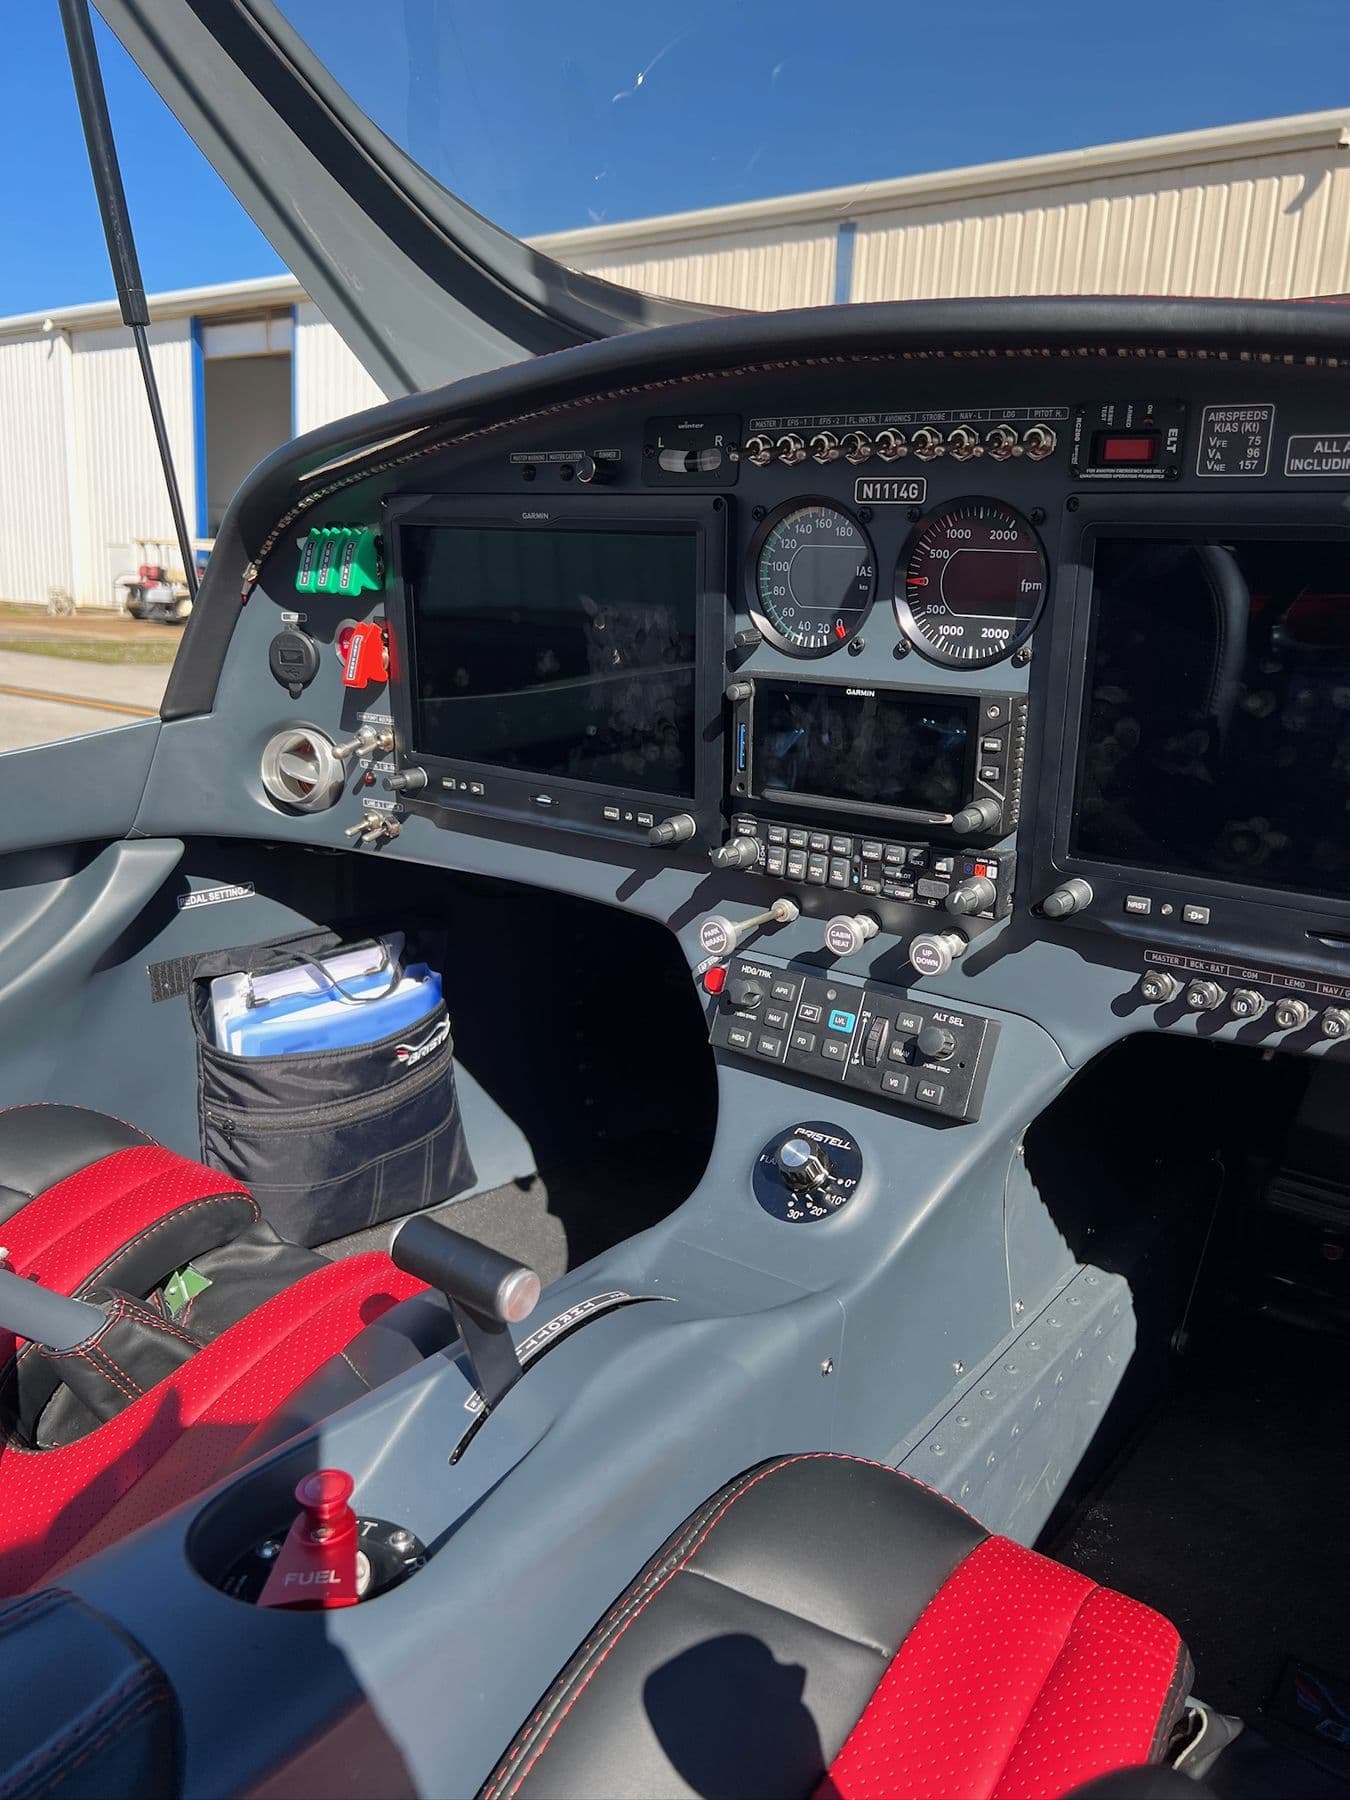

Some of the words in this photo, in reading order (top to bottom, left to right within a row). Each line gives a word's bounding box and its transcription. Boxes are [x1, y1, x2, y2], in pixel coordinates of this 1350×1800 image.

[922, 412, 946, 421] STROBE
[1034, 408, 1052, 417] PITOT
[1208, 410, 1268, 422] AIRSPEEDS
[884, 414, 912, 423] AVIONICS
[755, 420, 776, 428] MASTER
[1214, 422, 1239, 433] KIAS
[1241, 422, 1260, 434] (Kt)
[658, 437, 665, 448] L
[715, 435, 723, 446] R
[1167, 428, 1178, 453] ELT
[1248, 436, 1262, 446] 75
[1313, 441, 1340, 453] ALL
[1246, 448, 1260, 458] 96
[1239, 460, 1258, 470] 157
[863, 483, 918, 499] N1114G
[522, 512, 549, 520] GARMIN
[815, 519, 832, 528] 160
[795, 524, 812, 534] 140
[835, 527, 853, 537] 180
[946, 529, 972, 539] 1000
[989, 530, 1018, 540] 2000
[780, 539, 797, 549] 120
[929, 549, 950, 559] 500
[772, 561, 789, 571] 100
[856, 566, 872, 577] IAS
[773, 586, 785, 595] 80
[1021, 579, 1042, 593] fpm
[782, 608, 795, 617] 60
[926, 604, 946, 615] 500
[798, 621, 811, 631] 40
[817, 623, 830, 633] 20
[939, 625, 964, 636] 1000
[981, 628, 1009, 639] 2000
[846, 688, 875, 697] GARMIN
[895, 871, 912, 880] PILOT
[180, 894, 208, 906] PEDAL
[208, 886, 244, 901] SETTING
[1127, 901, 1147, 910] NRST
[703, 927, 720, 938] PARK
[830, 930, 851, 940] CABIN
[705, 934, 724, 947] BRAKE
[832, 939, 849, 947] HEAT
[922, 948, 933, 957] UP
[916, 957, 939, 967] DOWN
[1151, 953, 1179, 965] MASTER
[741, 965, 773, 979] HDG/TRK
[1242, 970, 1258, 979] COM
[1284, 978, 1306, 989] LEMO
[775, 986, 788, 995] APR
[1322, 985, 1339, 995] NAV
[1191, 993, 1204, 1004] 30
[1237, 1001, 1247, 1012] 10
[768, 1014, 781, 1023] NAV
[903, 1019, 914, 1028] IAS
[932, 1012, 947, 1022] ALT
[948, 1016, 964, 1027] SEL
[731, 1033, 745, 1043] HDG
[797, 1037, 807, 1045] FD
[762, 1042, 774, 1051] TRK
[829, 1046, 838, 1054] YD
[889, 1078, 899, 1087] VS
[922, 1088, 935, 1097] ALT
[514, 1302, 595, 1356] THROTT
[284, 1569, 342, 1587] FUEL
